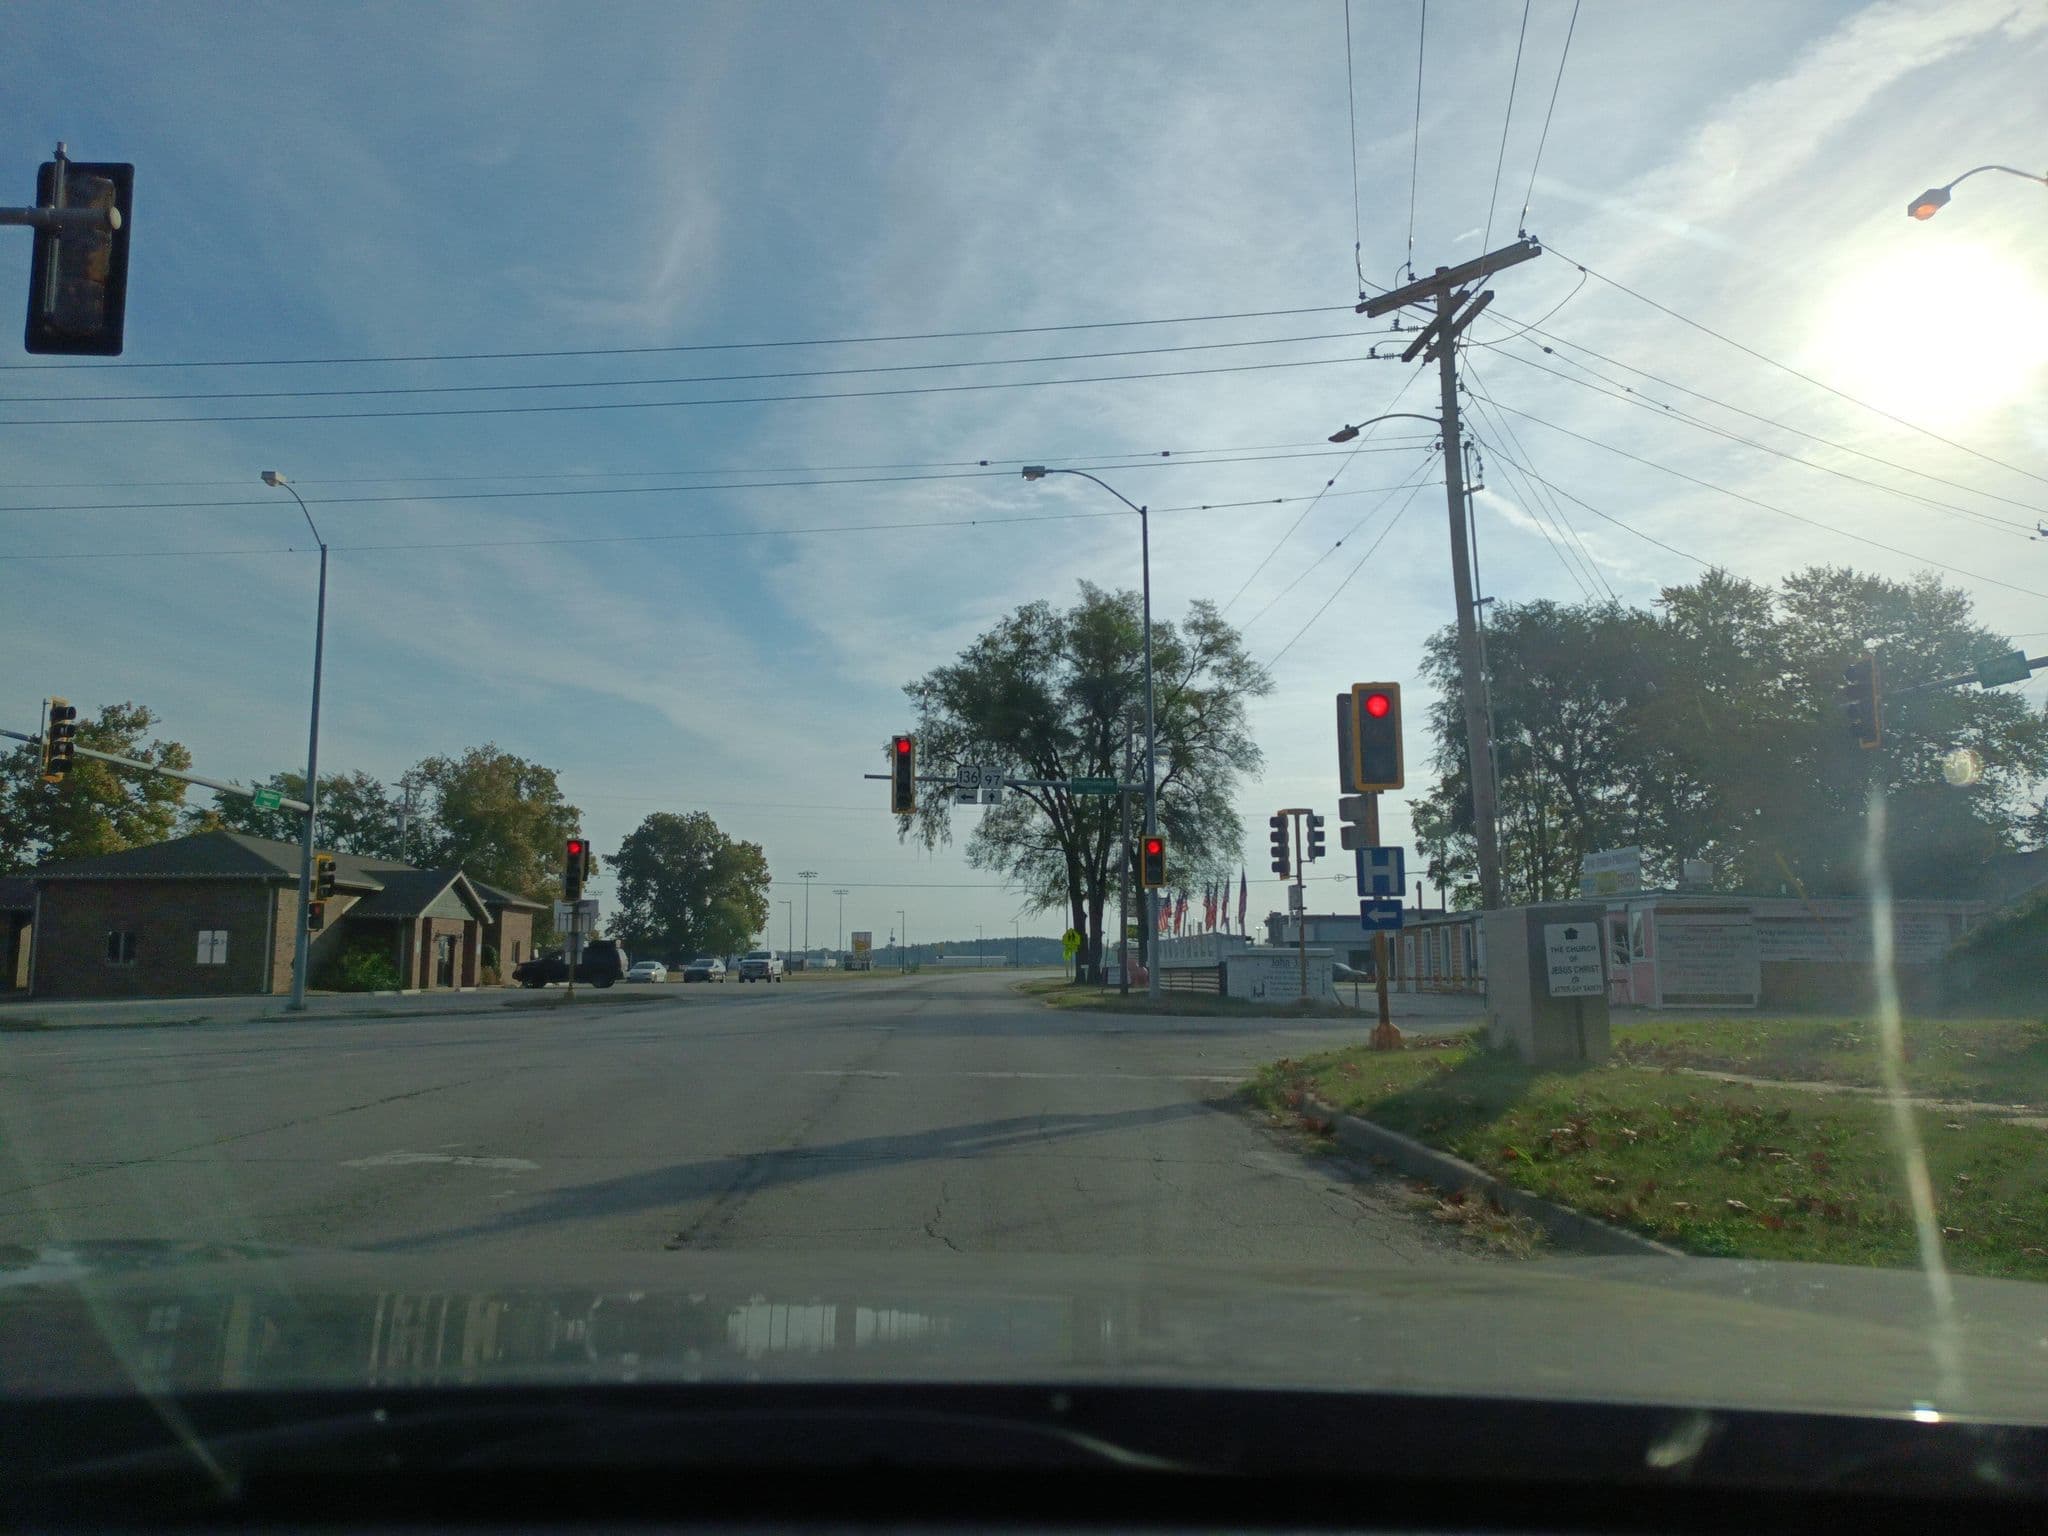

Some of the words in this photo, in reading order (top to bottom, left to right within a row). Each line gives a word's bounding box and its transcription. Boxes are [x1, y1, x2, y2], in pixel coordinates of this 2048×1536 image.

[959, 770, 978, 784] 136
[984, 774, 1001, 786] 97
[1362, 849, 1399, 894] H
[1566, 945, 1596, 953] CHURCH
[1552, 966, 1573, 975] JESUS
[1573, 965, 1600, 974] CHRIST
